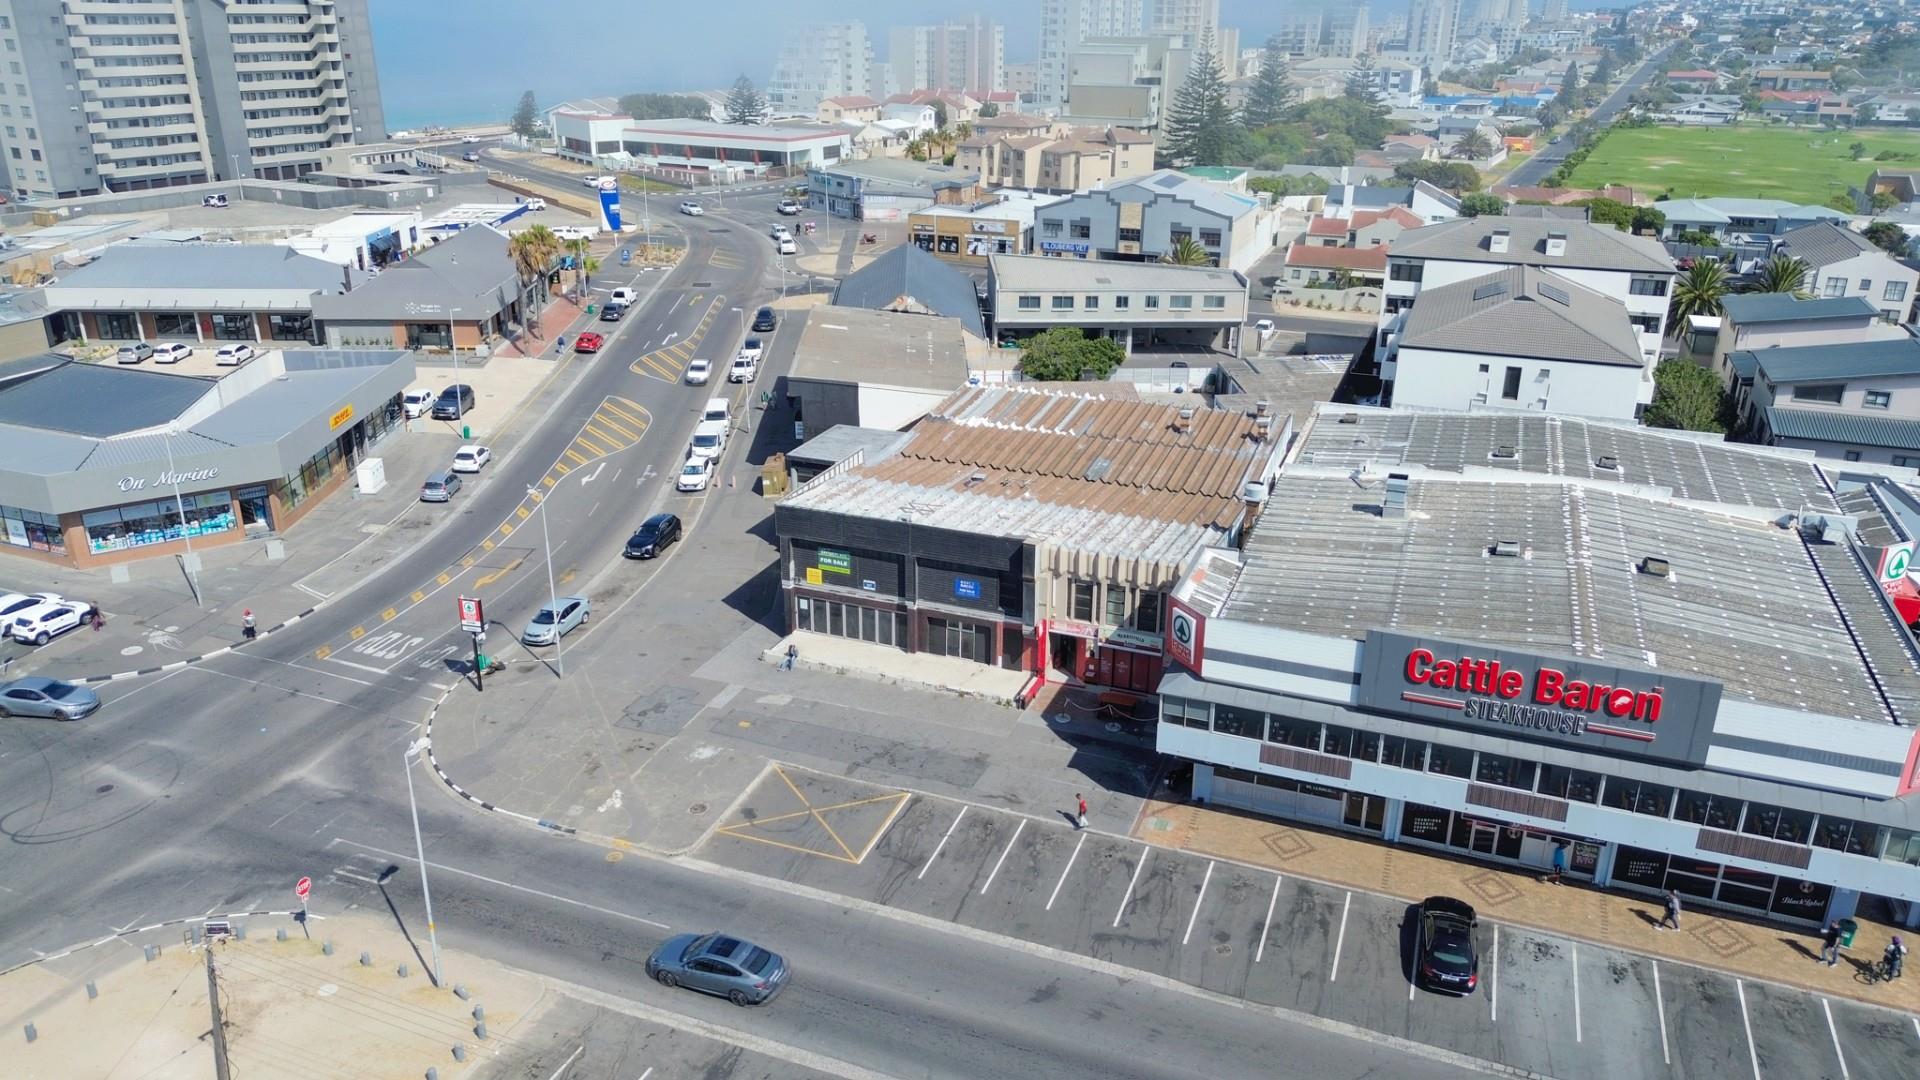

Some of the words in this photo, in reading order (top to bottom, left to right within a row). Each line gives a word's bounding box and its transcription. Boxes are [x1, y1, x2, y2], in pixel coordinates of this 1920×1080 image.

[118, 476, 145, 491] On
[152, 467, 219, 487] Marine
[352, 630, 424, 659] STOP
[1407, 647, 1525, 698] Cattle
[1535, 667, 1663, 721] Baron
[1465, 697, 1586, 736] STEAKHOUSE
[297, 880, 310, 892] STOP
[1782, 896, 1803, 905] Black
[1804, 898, 1825, 907] Label
